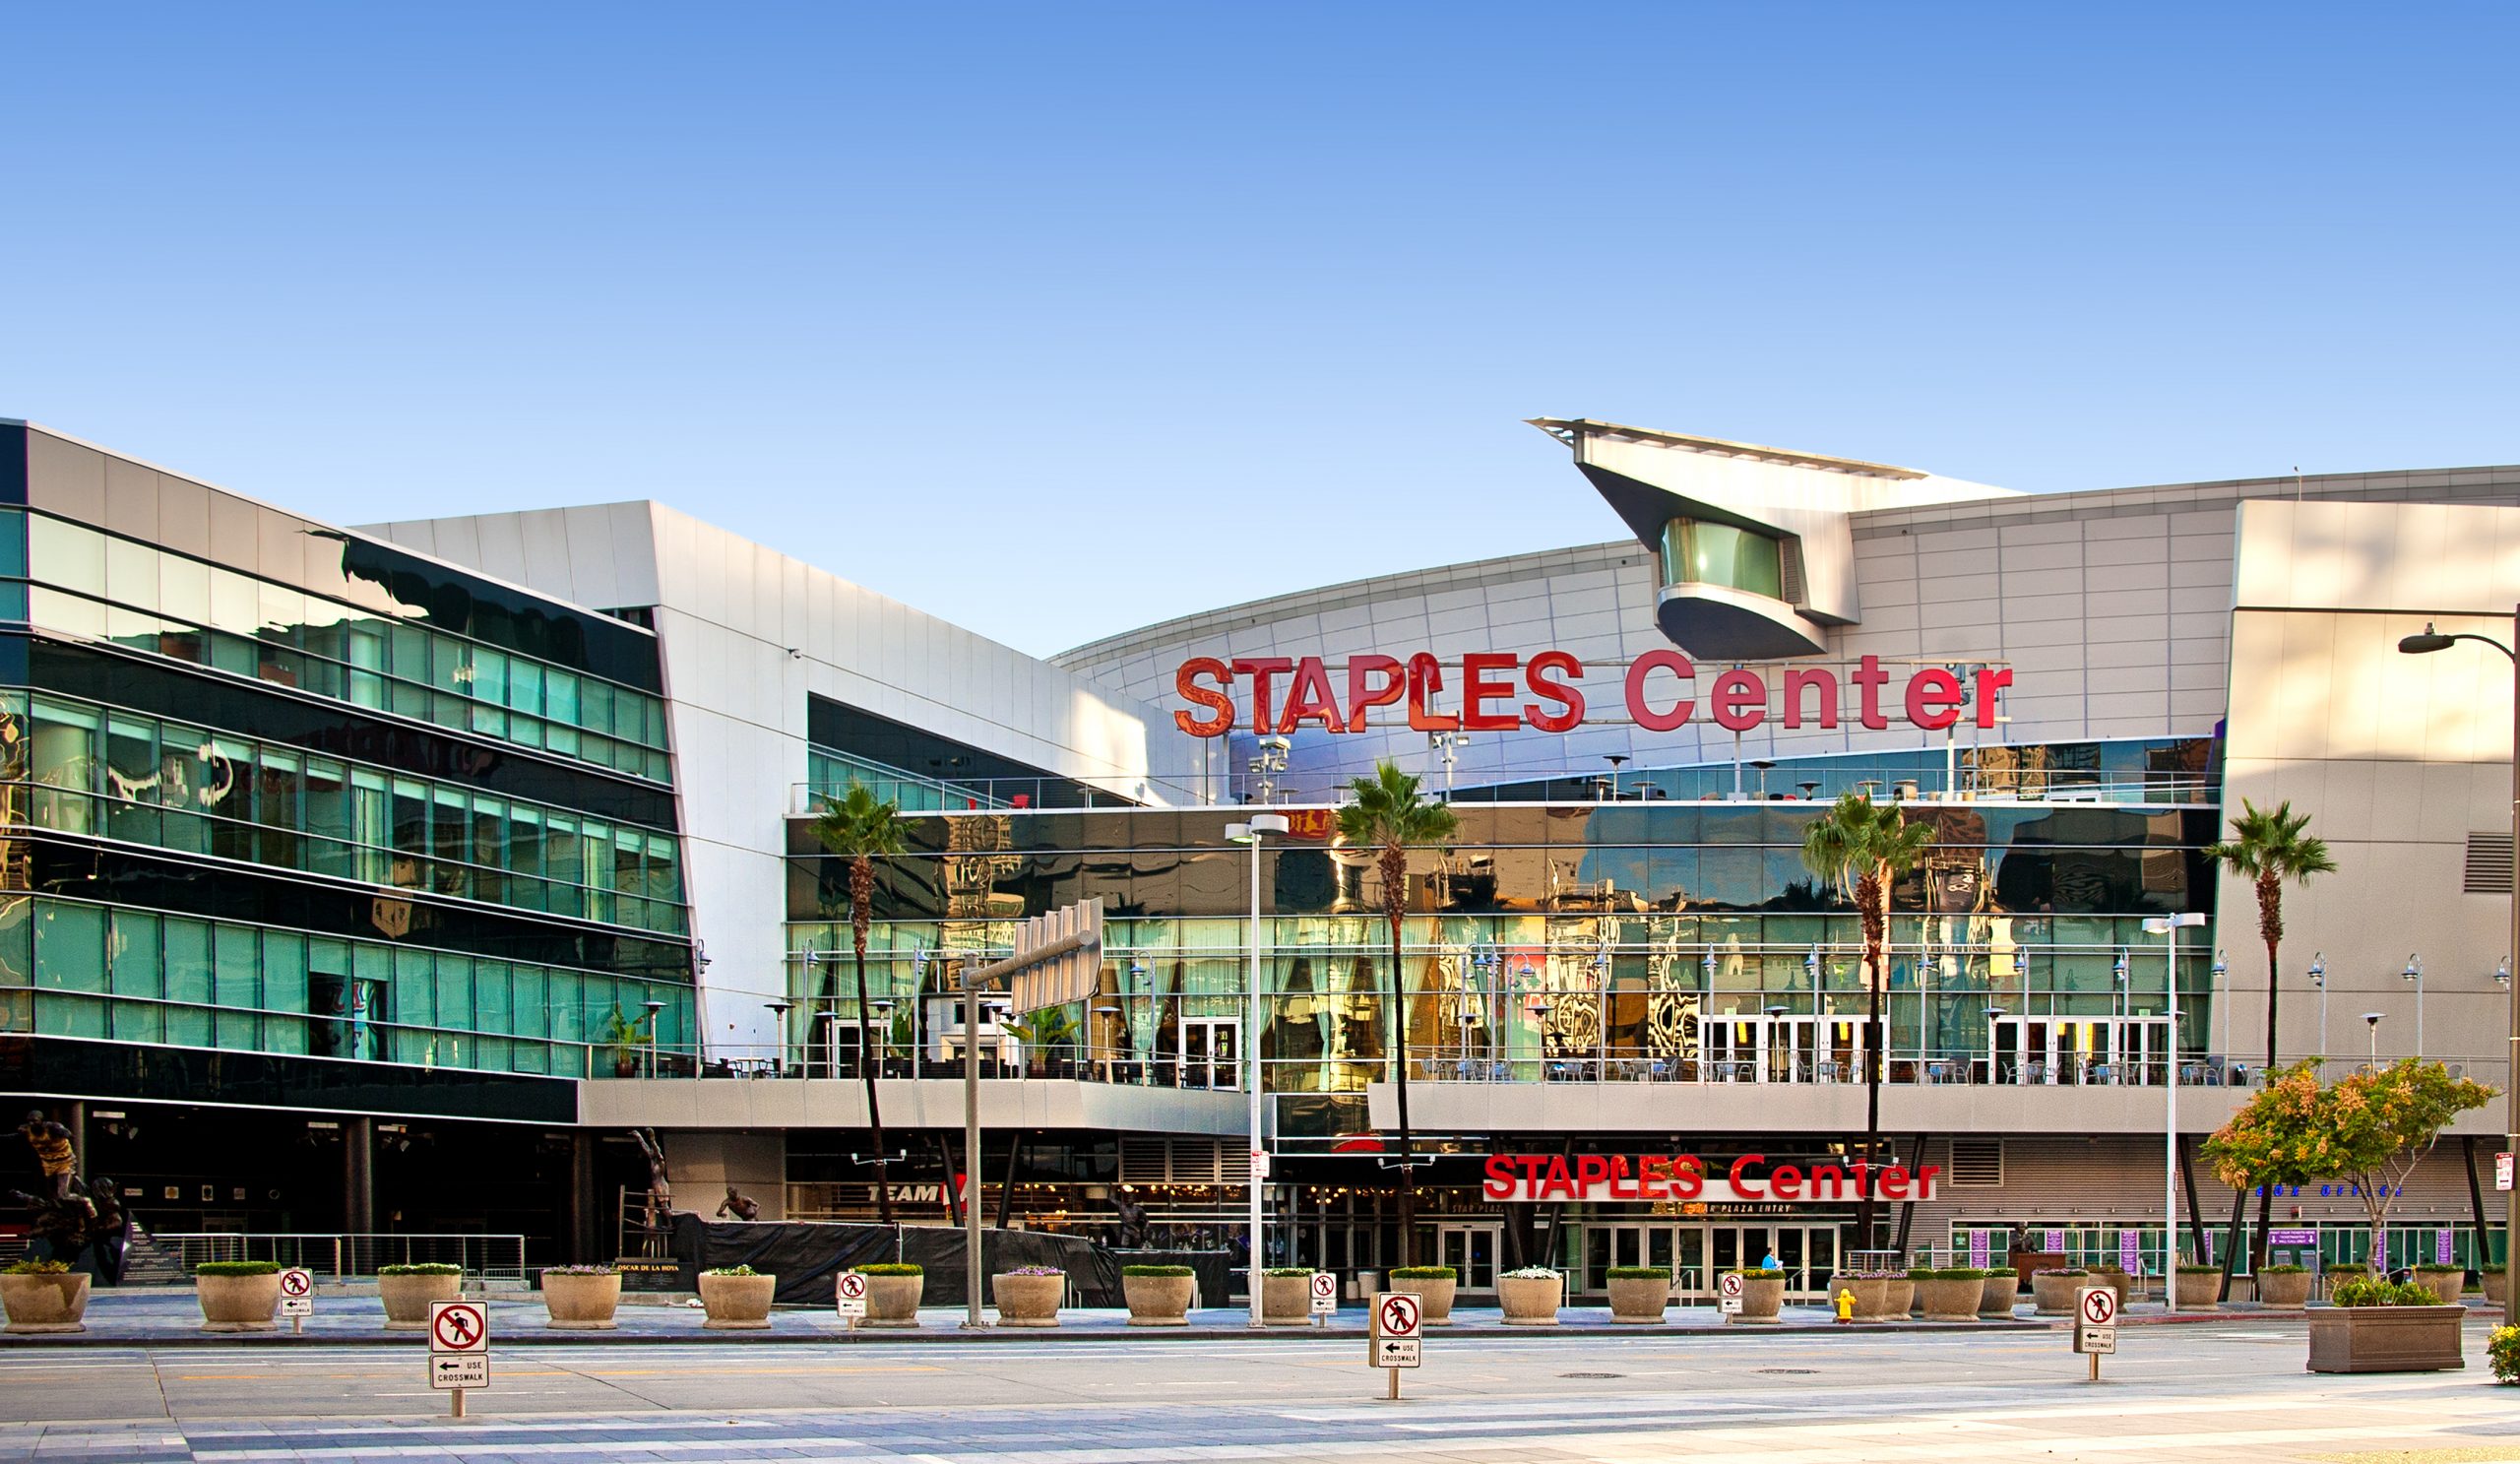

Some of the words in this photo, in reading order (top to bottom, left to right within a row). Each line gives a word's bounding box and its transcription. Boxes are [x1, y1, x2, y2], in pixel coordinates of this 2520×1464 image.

[1174, 651, 1586, 737] STAPLES
[1625, 650, 2013, 732] Center
[1483, 1154, 1703, 1198] STAPLES
[1730, 1154, 1940, 1198] Center
[867, 1185, 939, 1201] TEAM
[1479, 1204, 1504, 1213] PLAZ
[1722, 1204, 1753, 1213] PLAZA
[1759, 1204, 1791, 1213] ENTRY
